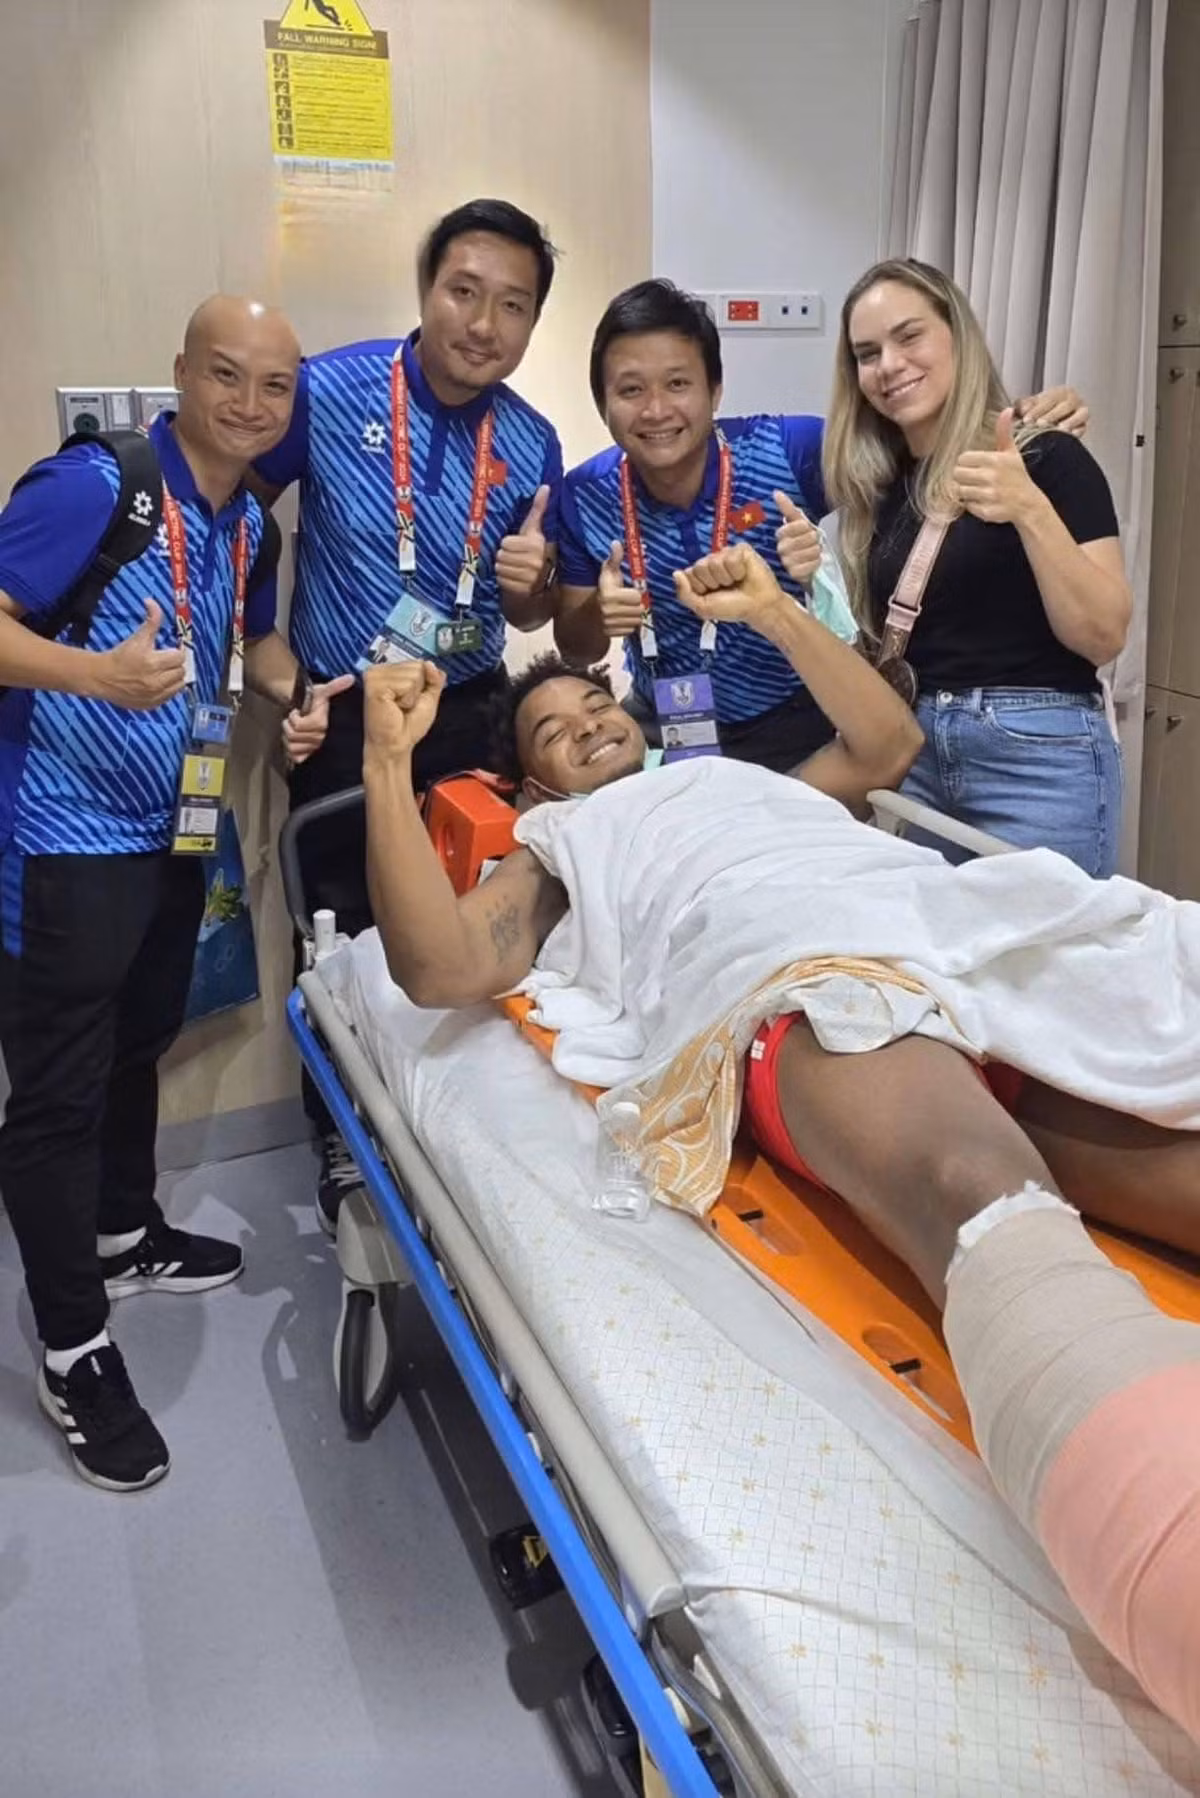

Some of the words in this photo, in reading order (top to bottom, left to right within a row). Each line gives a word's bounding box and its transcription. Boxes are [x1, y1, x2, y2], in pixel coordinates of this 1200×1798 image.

[277, 31, 299, 42] FALL
[303, 35, 350, 47] WARNING
[398, 443, 406, 461] CUP
[476, 479, 485, 497] CUP
[171, 541, 182, 560] CUP
